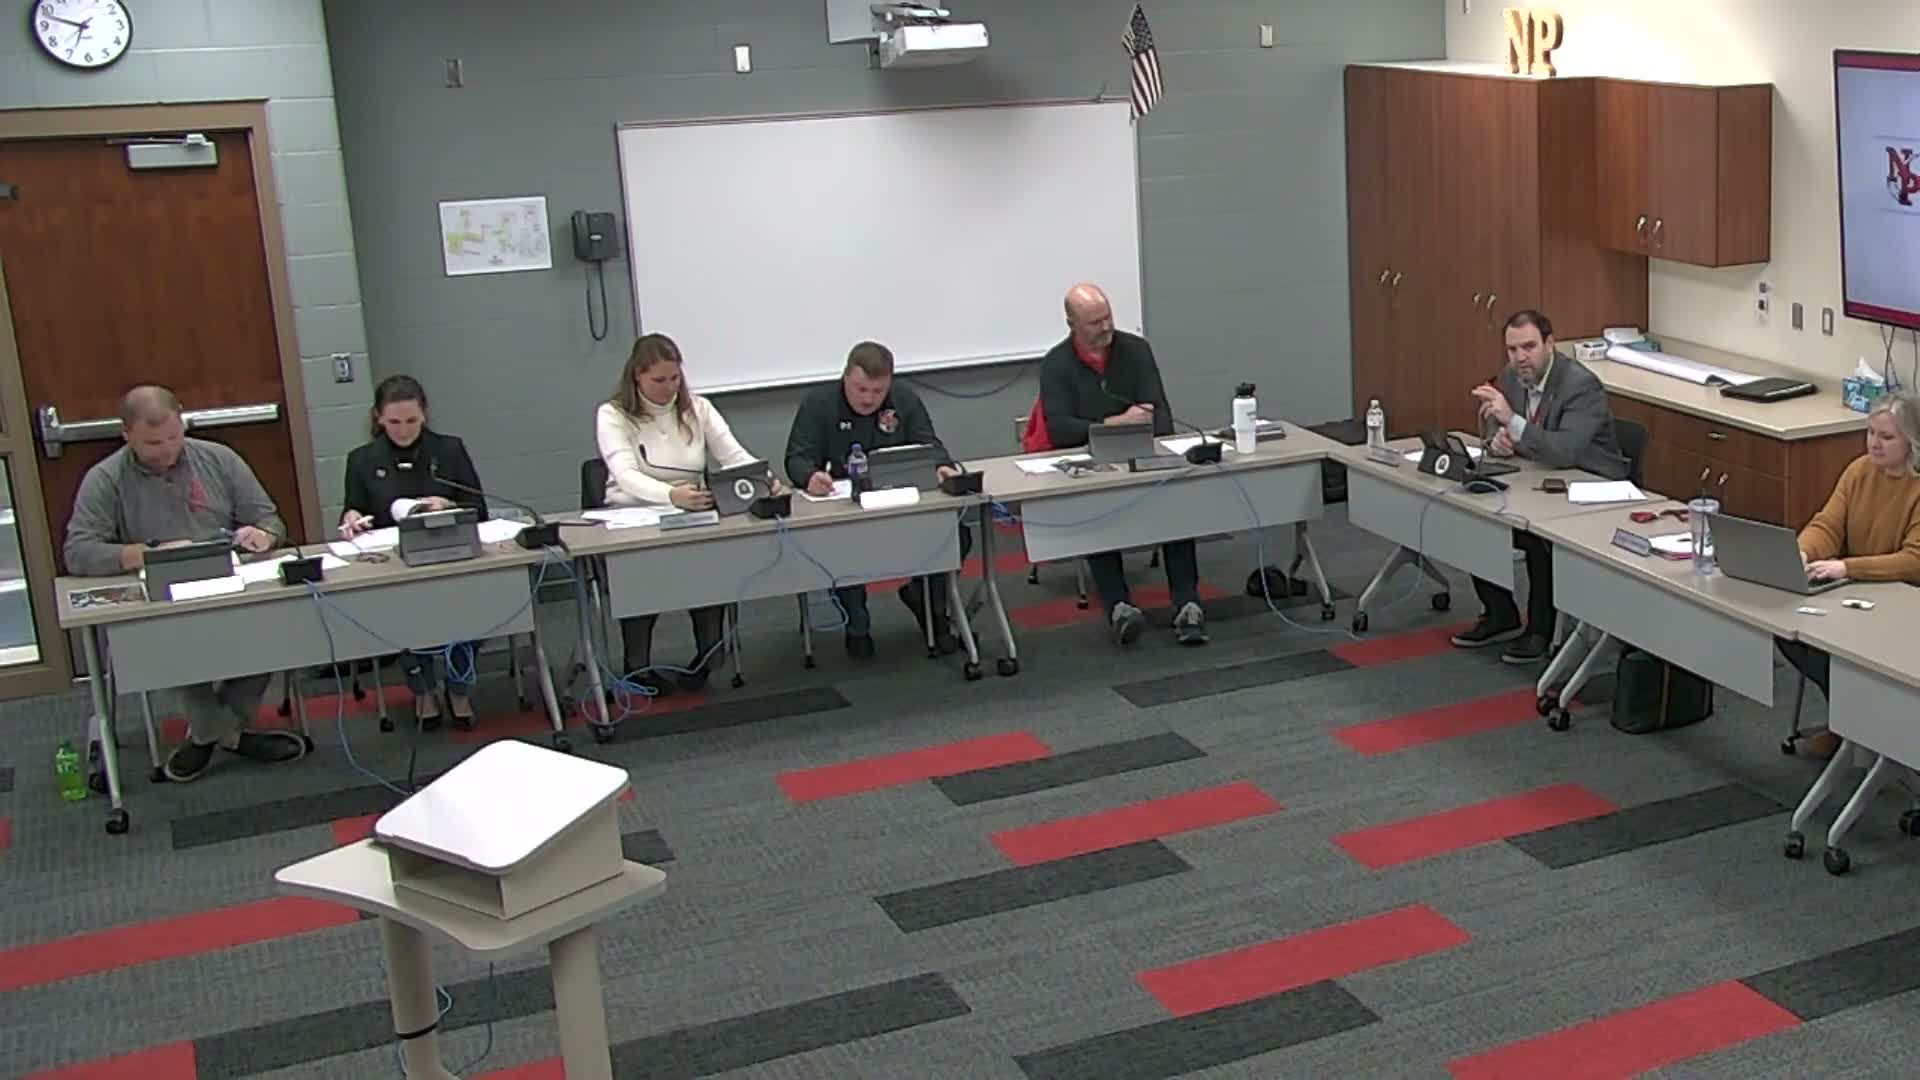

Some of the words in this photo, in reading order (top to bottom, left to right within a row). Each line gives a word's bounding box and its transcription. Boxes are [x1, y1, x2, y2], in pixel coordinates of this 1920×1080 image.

[41, 4, 54, 16] 10
[107, 4, 117, 15] 2
[40, 20, 50, 32] 9
[116, 19, 125, 30] 3
[48, 35, 58, 47] 8
[113, 35, 122, 46] 4
[1503, 8, 1564, 79] NP
[65, 48, 74, 60] 7
[84, 52, 94, 63] 6
[101, 48, 110, 59] 5
[1885, 146, 1920, 206] NP
